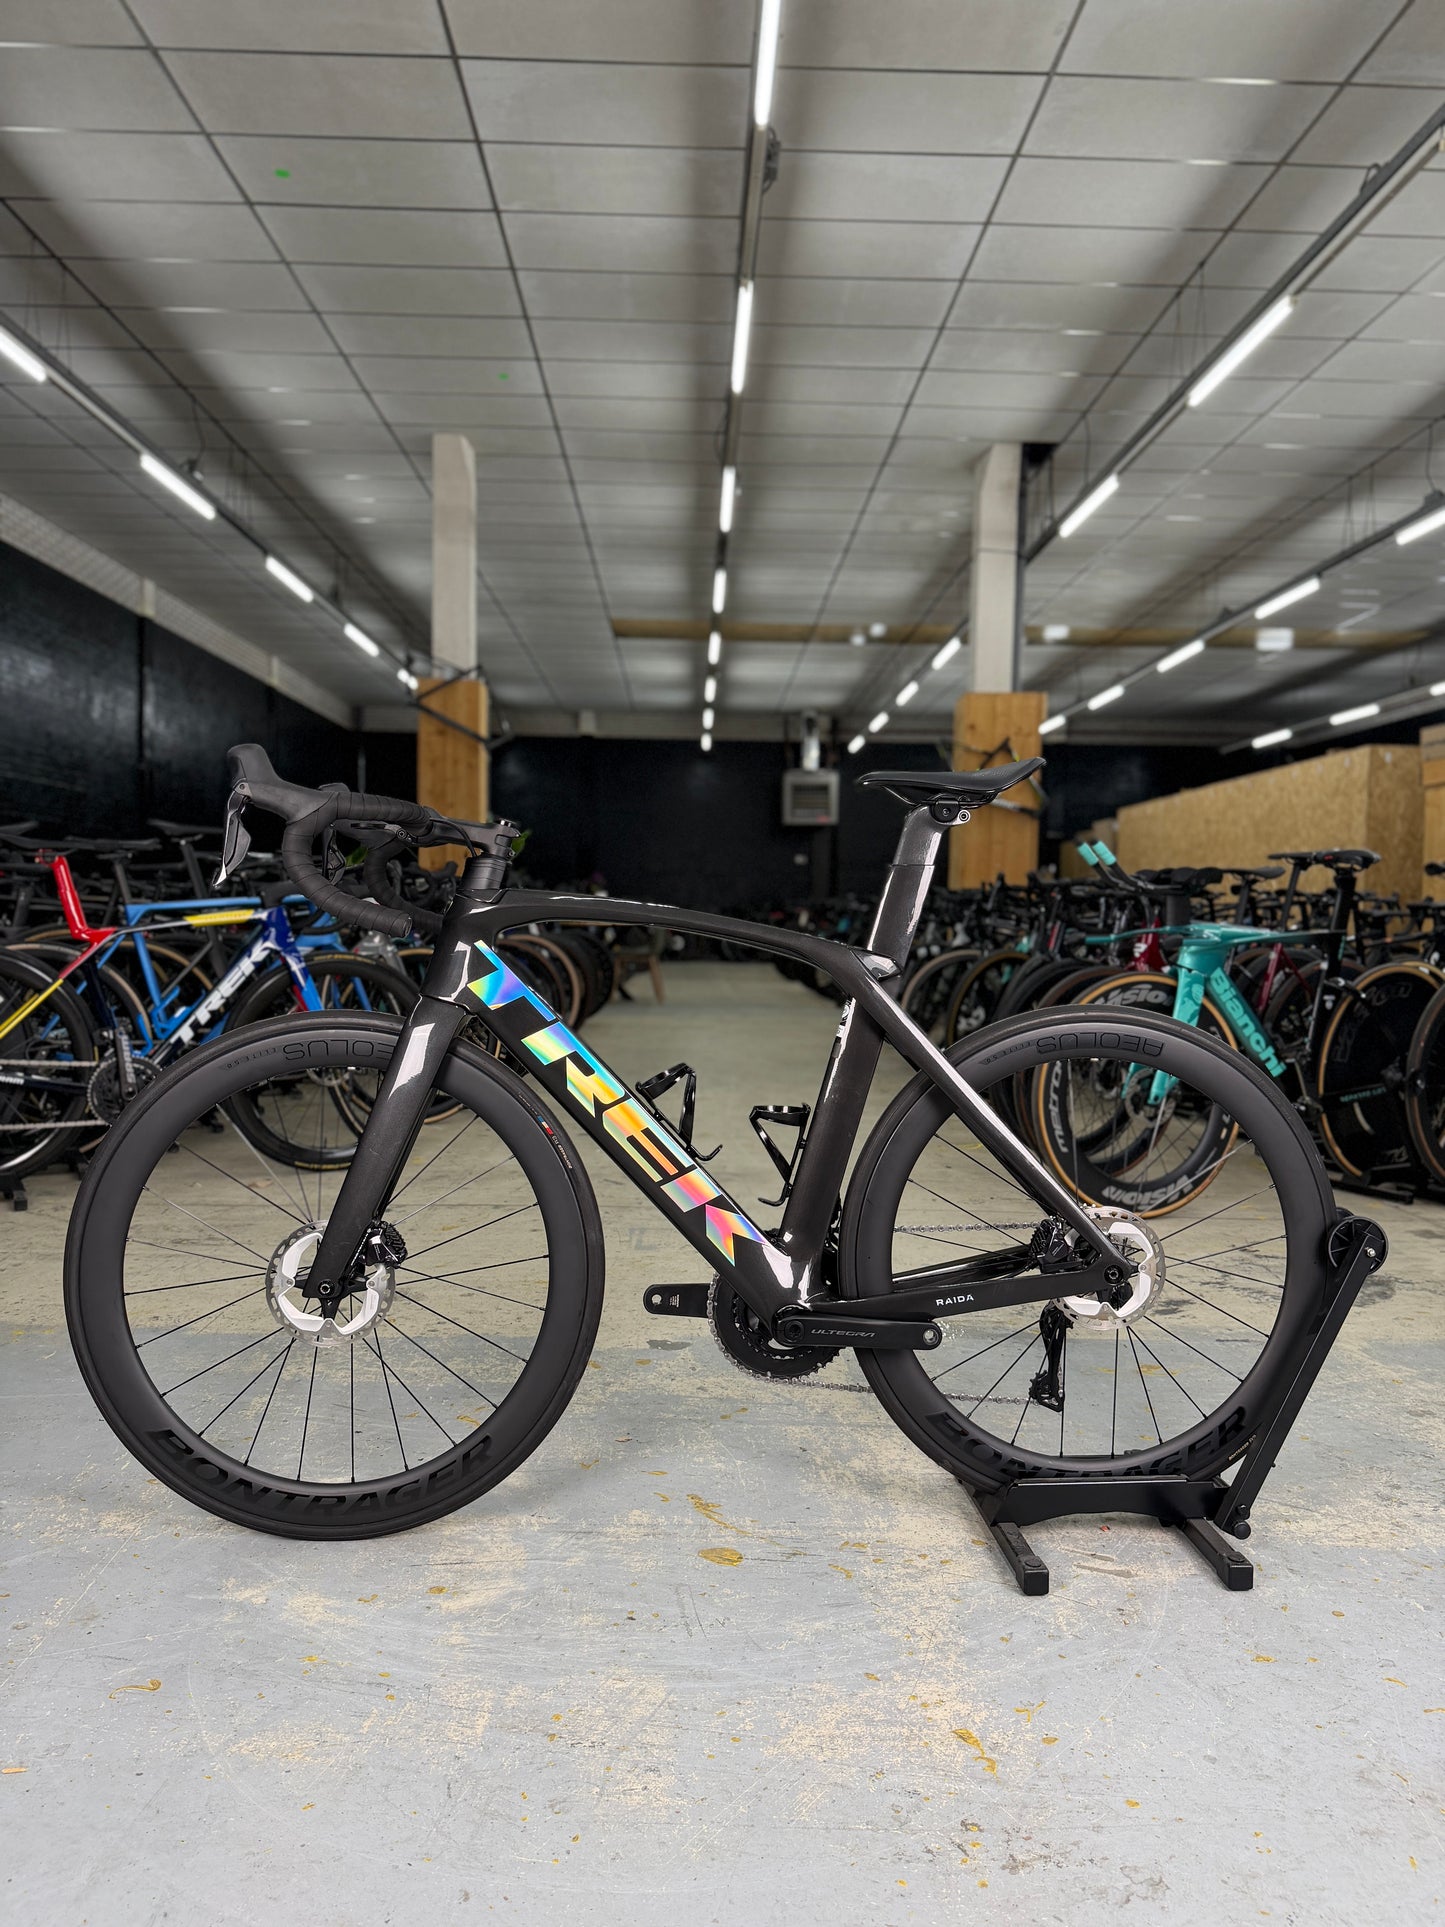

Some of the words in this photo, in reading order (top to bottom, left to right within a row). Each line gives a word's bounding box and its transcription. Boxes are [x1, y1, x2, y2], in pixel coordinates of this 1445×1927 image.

[169, 937, 272, 1044] TREK
[282, 1039, 396, 1061] EOLUS
[1036, 1031, 1165, 1057] AEOLUS
[1209, 967, 1287, 1077] Bianchi
[467, 940, 768, 1267] TREK
[936, 1294, 974, 1307] RAIDA
[811, 1328, 876, 1338] ULTEGRA
[149, 1429, 493, 1516] BONTRAGER
